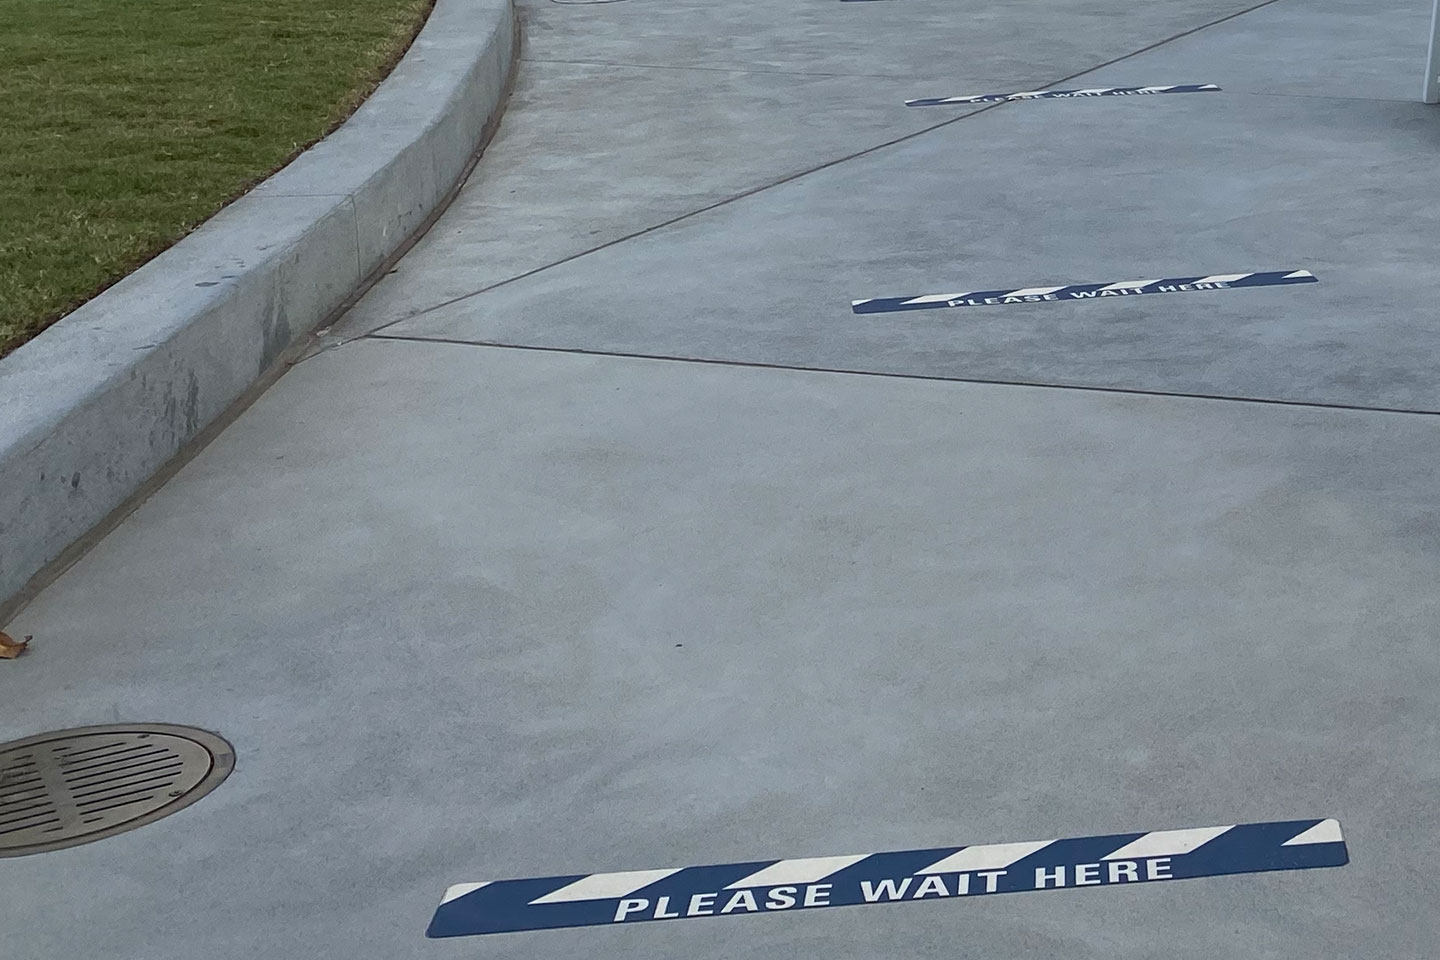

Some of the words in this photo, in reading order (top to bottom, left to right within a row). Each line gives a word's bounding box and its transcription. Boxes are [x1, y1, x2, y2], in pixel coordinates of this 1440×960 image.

[948, 294, 1057, 308] PLEASE
[1070, 286, 1146, 300] WAIT
[1158, 280, 1232, 293] HERE
[613, 882, 832, 922] PLEASE
[861, 870, 1008, 902] WAIT
[1034, 856, 1174, 889] HERE
